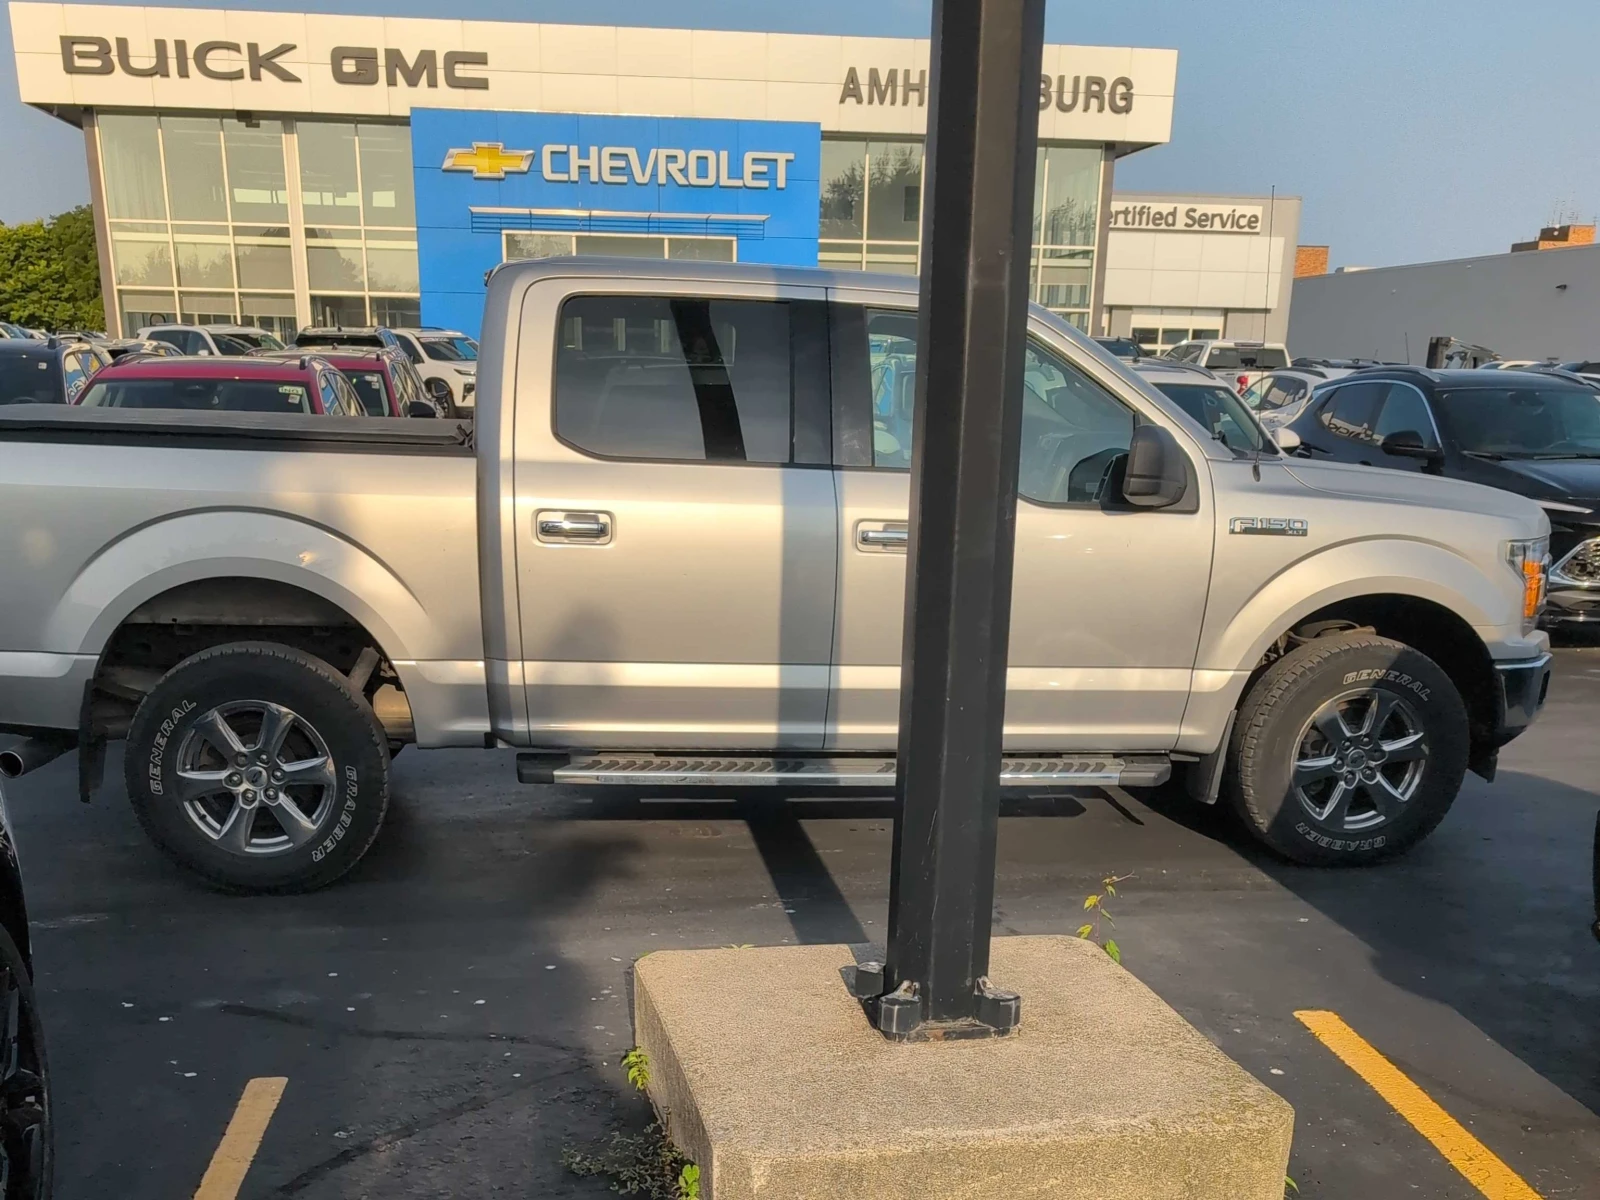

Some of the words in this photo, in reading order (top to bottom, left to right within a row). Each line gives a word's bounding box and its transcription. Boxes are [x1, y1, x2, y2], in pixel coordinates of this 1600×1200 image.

[59, 35, 302, 83] BUICK
[330, 46, 489, 90] GMC
[839, 66, 1134, 114] AMHBURG
[541, 143, 795, 190] CHEVROLET
[1183, 207, 1260, 231] Service
[1342, 668, 1432, 702] GENERAL
[148, 699, 197, 796] GENERAL
[311, 765, 358, 862] GRABBER
[1295, 822, 1386, 852] GRABBER
